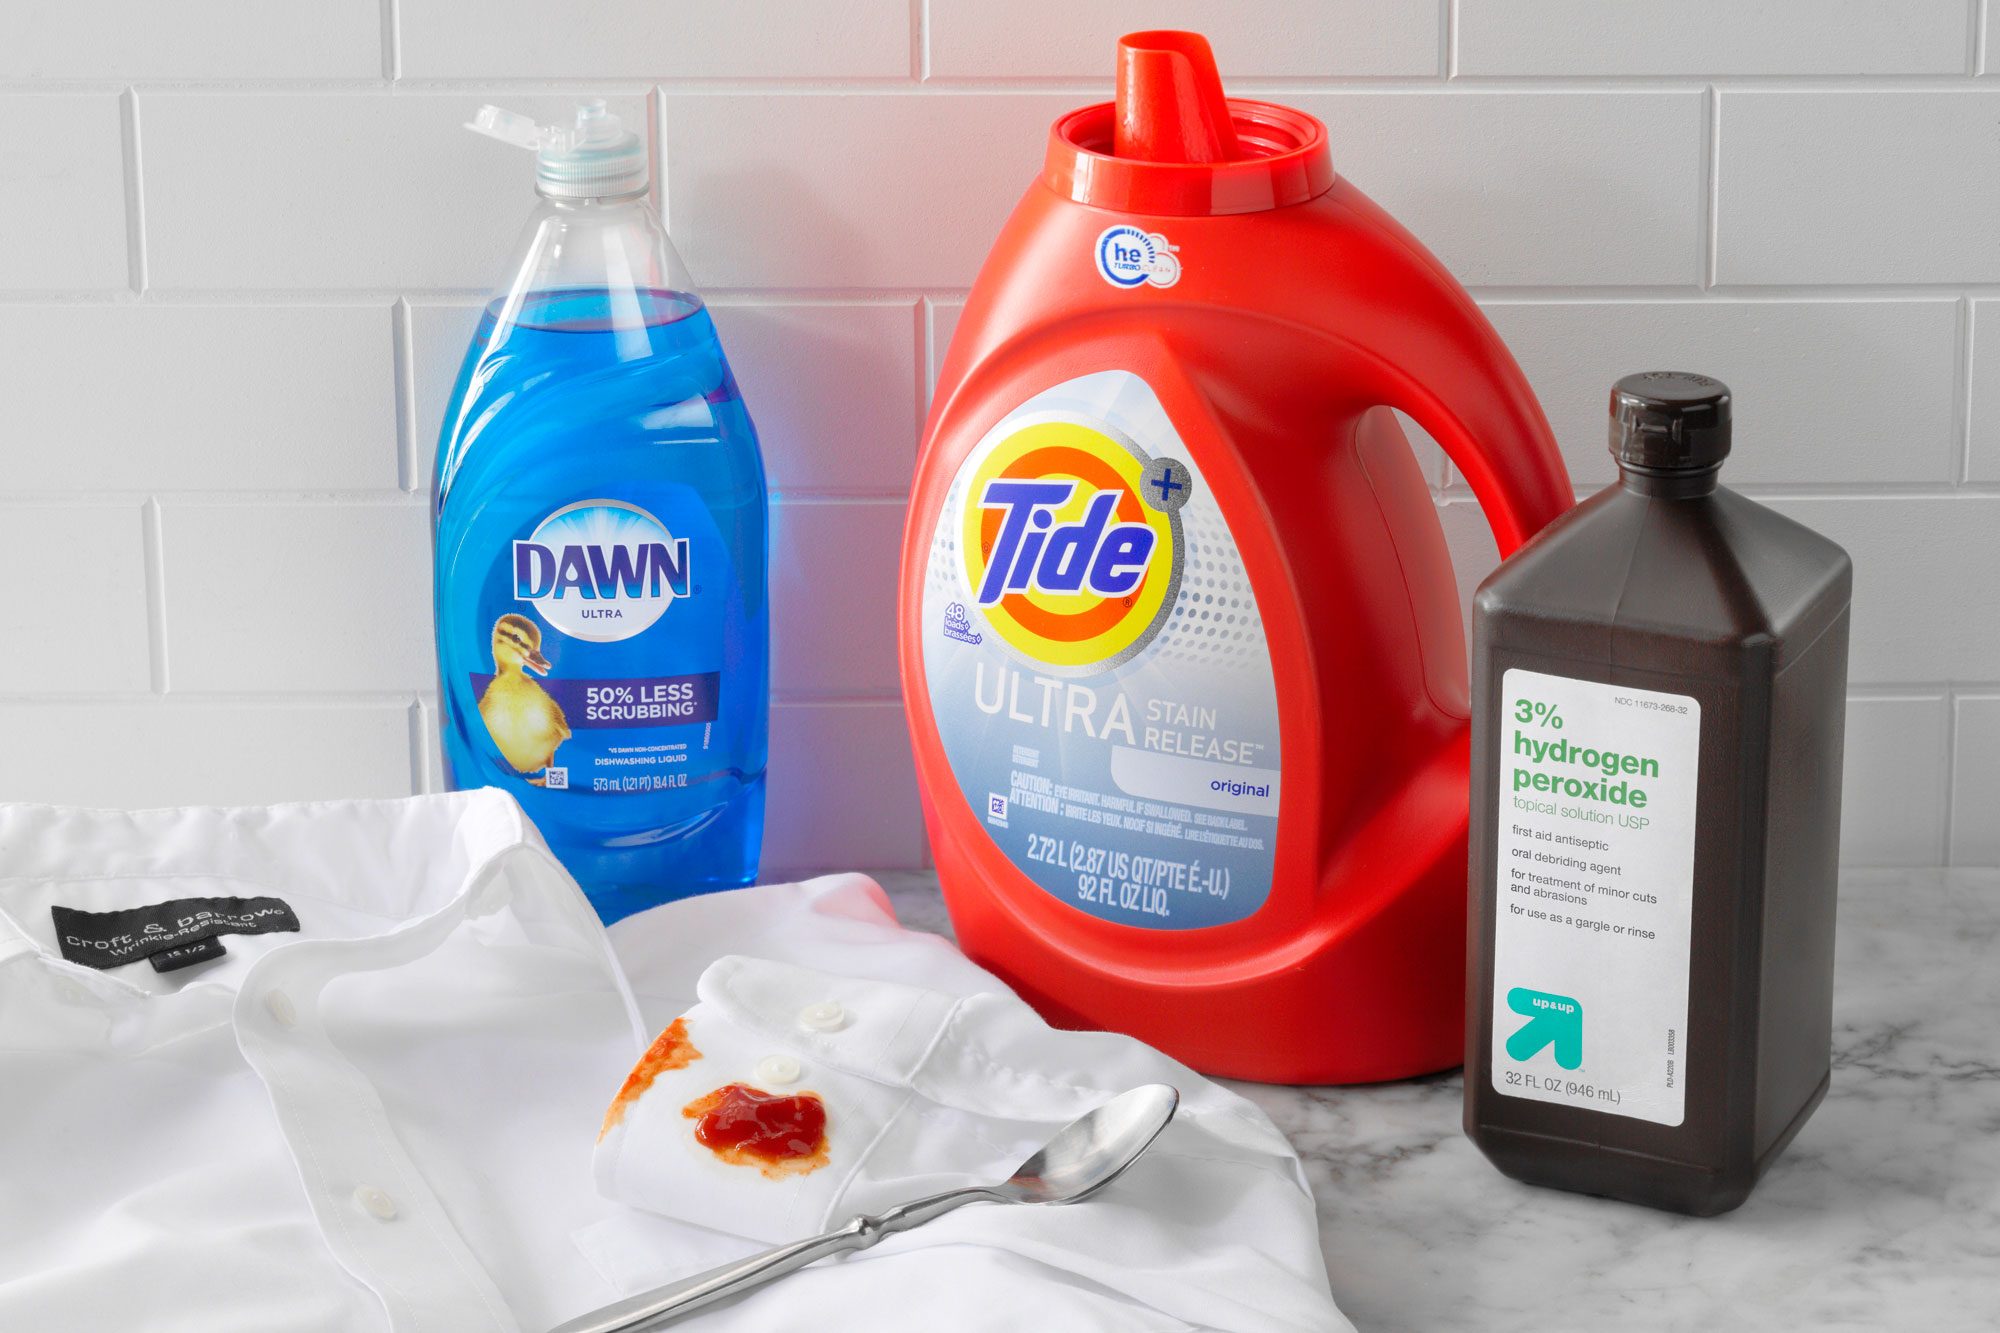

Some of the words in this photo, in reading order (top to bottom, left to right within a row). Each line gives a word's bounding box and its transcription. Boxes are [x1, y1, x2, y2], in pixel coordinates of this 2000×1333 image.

[1114, 242, 1141, 262] he
[978, 483, 1153, 603] Tide
[515, 539, 689, 599] DAWN
[581, 609, 623, 619] ULTRA
[946, 603, 964, 620] 48
[587, 687, 634, 704] 50%
[641, 683, 694, 703] LESS
[975, 662, 1136, 745] ULTRA
[1614, 697, 1632, 706] NDC
[1146, 700, 1217, 730] STAIN
[1514, 698, 1564, 730] 3%
[595, 756, 656, 766] DISHWASHING
[658, 754, 687, 763] LIQUID
[1514, 730, 1659, 778] hydrogen
[593, 778, 608, 791] 573
[1010, 770, 1053, 795] CAUTION:
[1210, 780, 1270, 798] original
[1513, 768, 1648, 808] peroxide
[1513, 795, 1557, 816] topical
[1561, 807, 1614, 825] solution
[1618, 814, 1650, 830] USP
[1512, 824, 1532, 838] first
[1535, 830, 1552, 842] aid
[1555, 834, 1609, 851] antiseptic
[1027, 833, 1057, 865] 2.72
[1058, 840, 1068, 868] L
[1070, 841, 1106, 874] (2.87
[1108, 850, 1130, 880] US
[1132, 855, 1186, 890] QT/PTE
[1512, 848, 1532, 860] oral
[1534, 852, 1586, 872] debriding
[1590, 863, 1622, 876] agent
[1078, 874, 1096, 902] 92
[1099, 878, 1117, 906] FL
[1120, 882, 1141, 910] OZ
[1142, 886, 1170, 917] LIQ.
[1510, 882, 1531, 895] and
[1534, 888, 1588, 906] abrasions
[1511, 868, 1526, 880] for
[1528, 872, 1581, 890] treatment
[1584, 883, 1596, 893] of
[1598, 886, 1630, 900] minor
[1632, 892, 1658, 904] cuts
[144, 924, 167, 934] &
[1510, 904, 1525, 914] for
[1528, 909, 1546, 920] use
[1550, 914, 1562, 923] as
[1566, 916, 1572, 925] a
[1576, 918, 1610, 932] gargle
[1613, 925, 1625, 934] or
[1628, 927, 1656, 940] rinse
[109, 918, 257, 956] Wrinkle-Resistant
[1532, 998, 1574, 1014] up&up
[1505, 1071, 1522, 1086] 32
[1526, 1075, 1540, 1089] FL
[1544, 1078, 1562, 1092] OZ
[1565, 1082, 1594, 1098] (946
[1598, 1088, 1621, 1105] mL)
